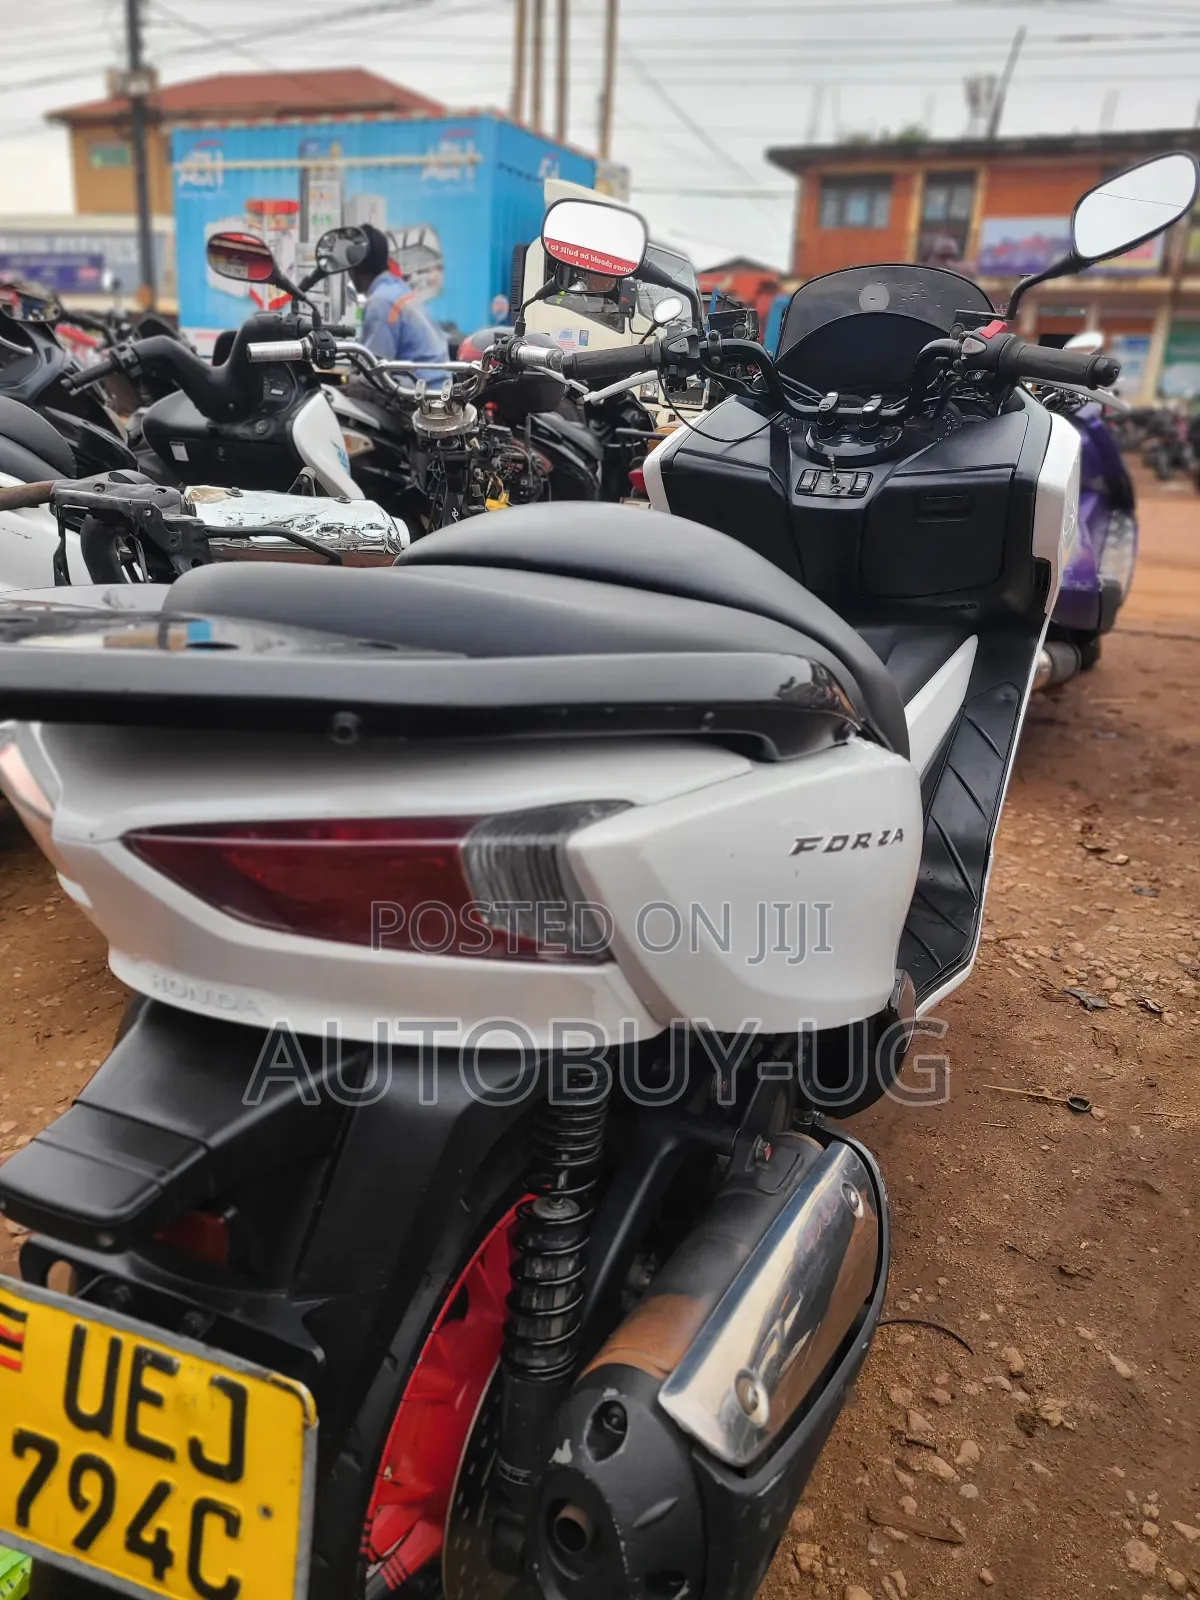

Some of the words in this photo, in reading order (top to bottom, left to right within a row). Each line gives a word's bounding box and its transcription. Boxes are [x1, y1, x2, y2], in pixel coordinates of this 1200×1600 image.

[789, 827, 904, 856] FORZA
[150, 972, 265, 1018] HONDA
[63, 1322, 249, 1484] UEJ
[11, 1427, 243, 1600] 794C
